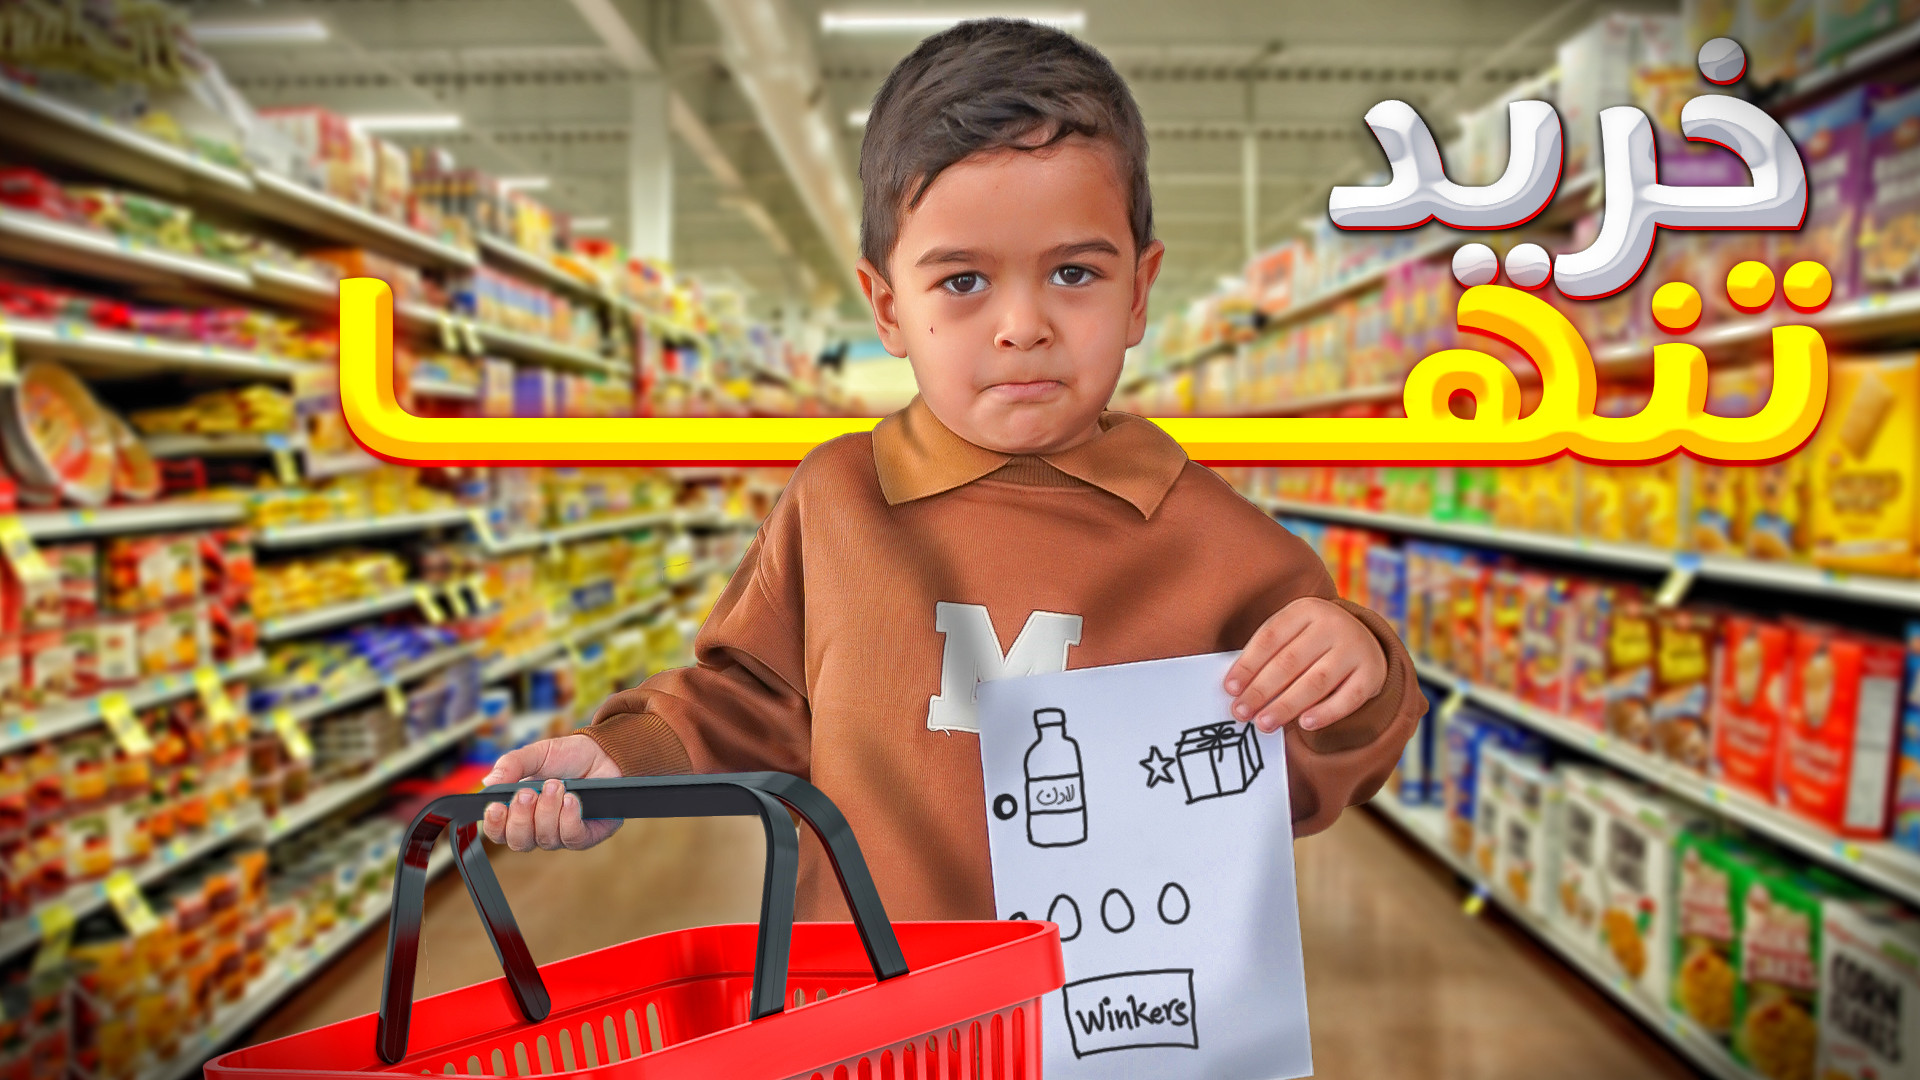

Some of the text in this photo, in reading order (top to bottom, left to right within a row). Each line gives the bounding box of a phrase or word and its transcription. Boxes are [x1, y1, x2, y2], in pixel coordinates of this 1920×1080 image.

[927, 601, 1083, 734] M
[1036, 784, 1075, 806] لادن
[1075, 994, 1190, 1036] Winkers
